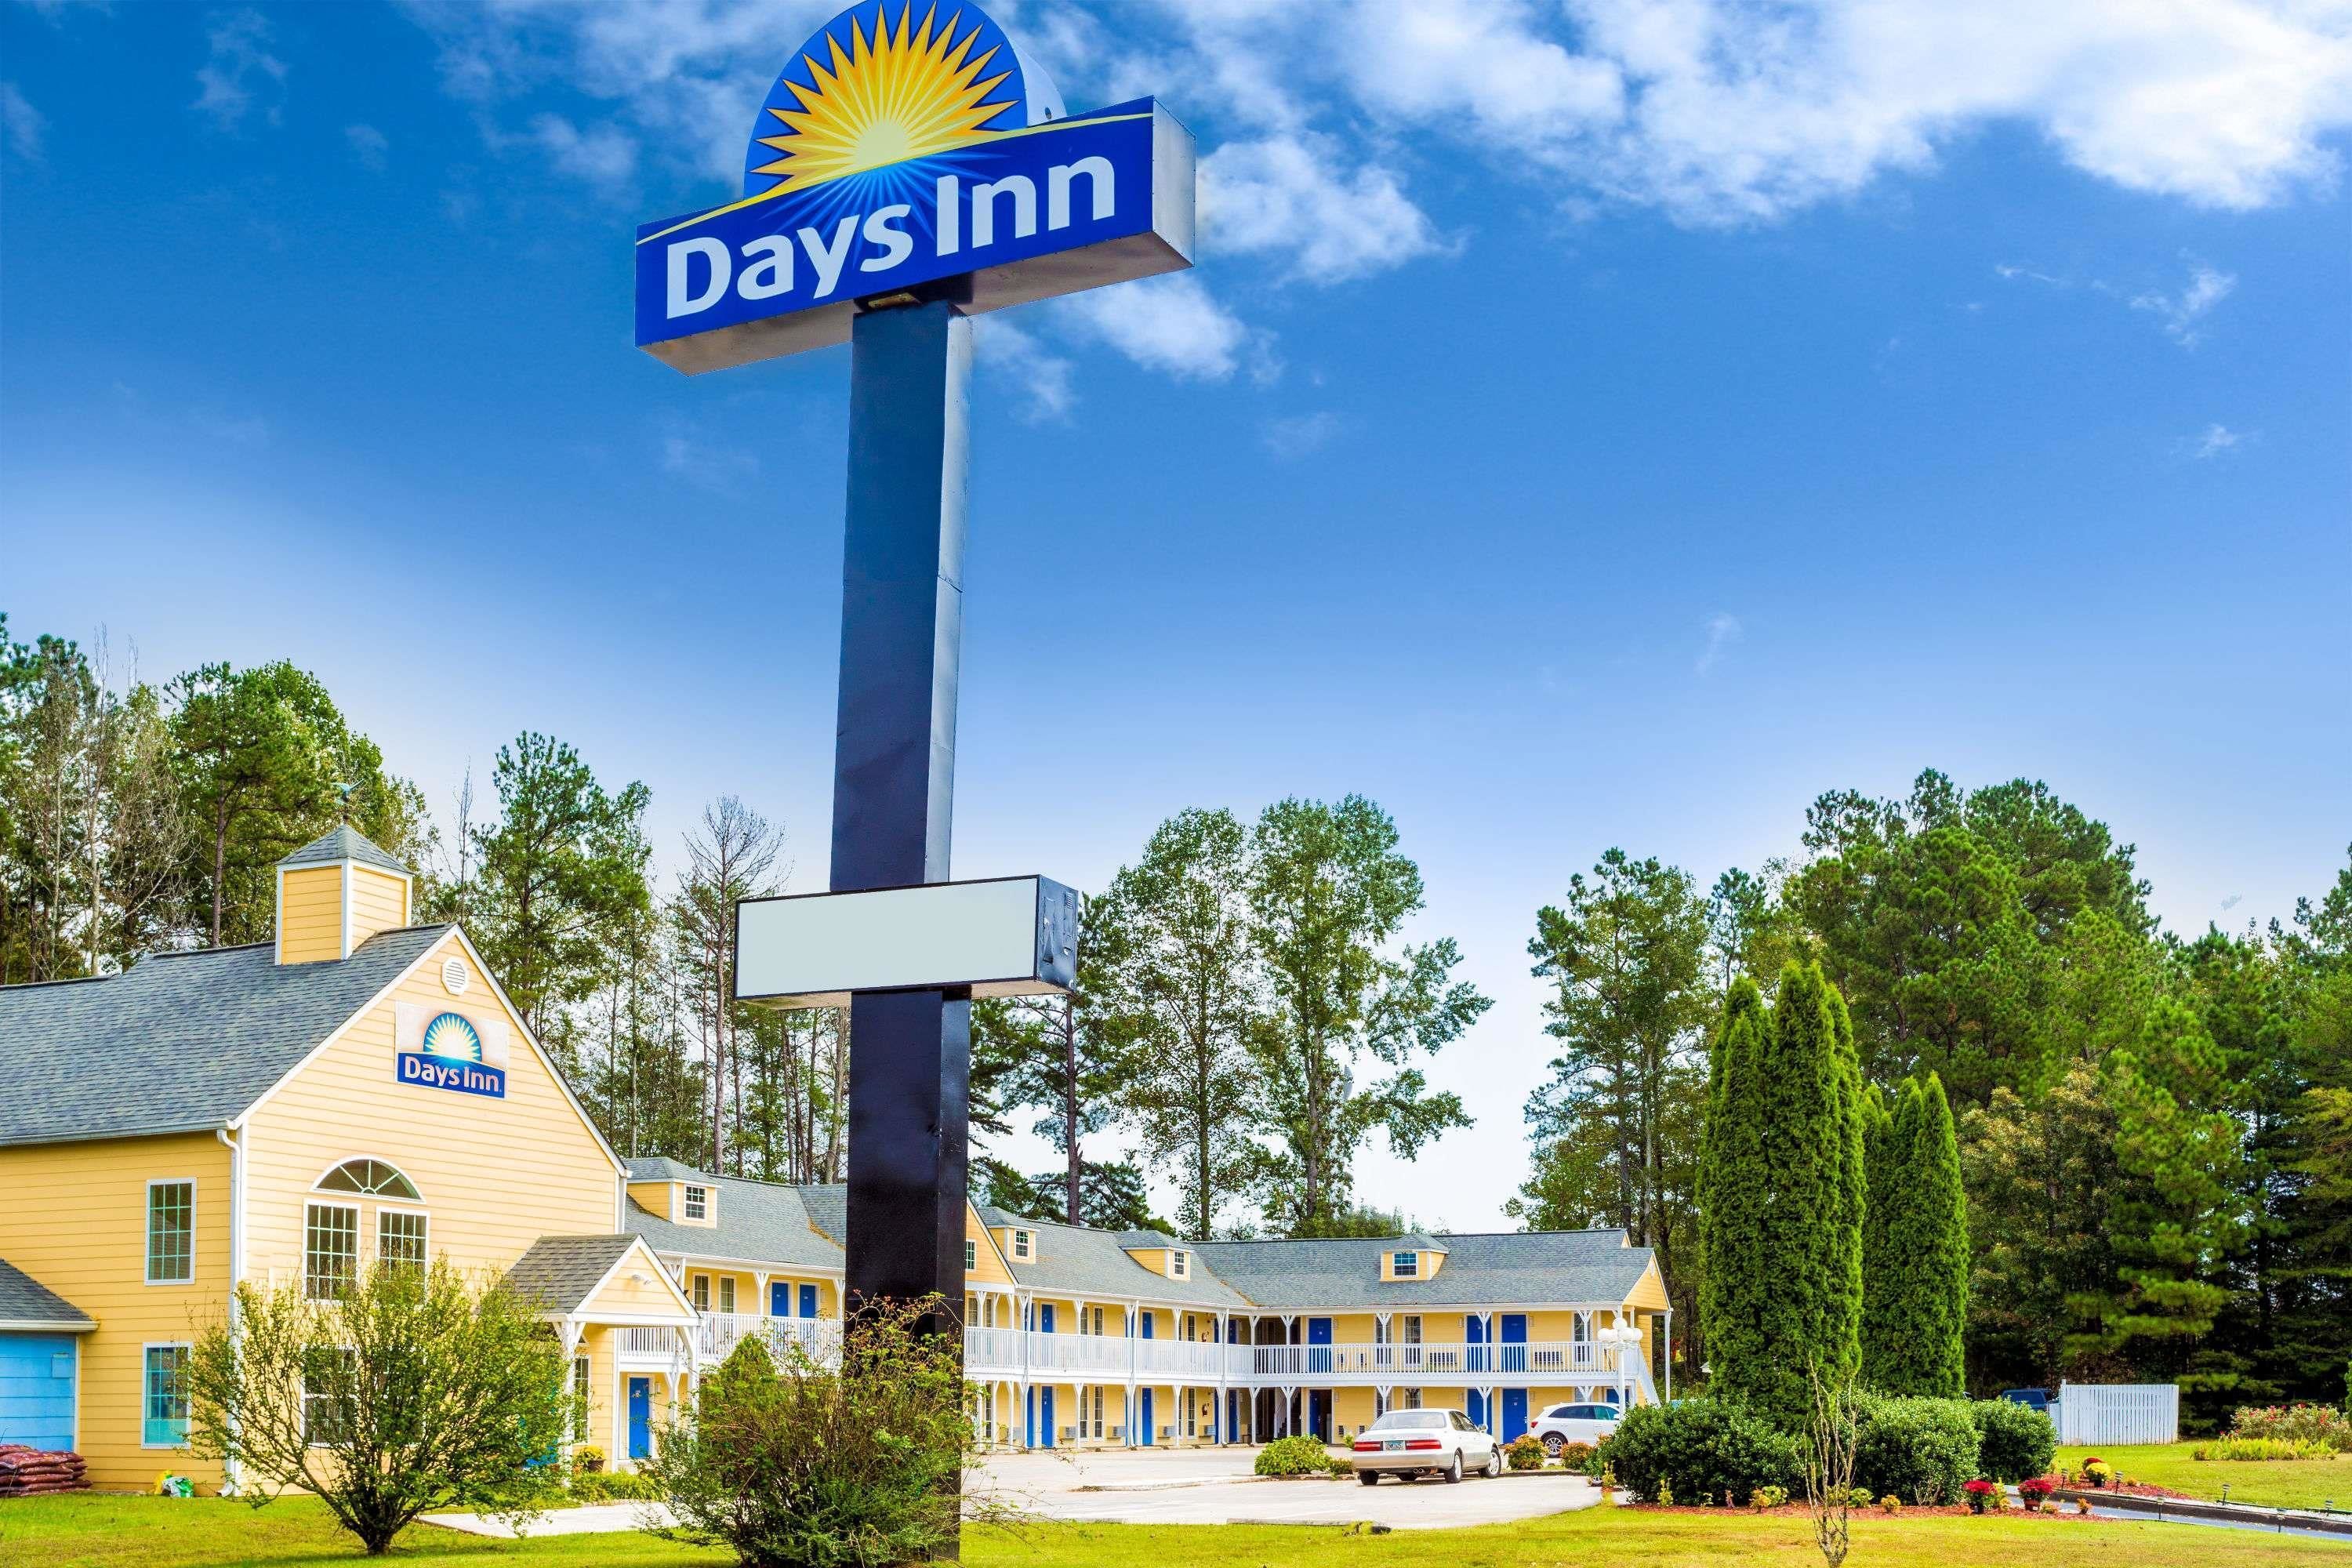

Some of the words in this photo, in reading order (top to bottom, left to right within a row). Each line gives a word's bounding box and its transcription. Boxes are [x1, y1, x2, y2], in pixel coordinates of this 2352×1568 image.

[666, 204, 913, 319] Days
[936, 156, 1115, 256] Inn
[405, 1056, 461, 1087] Days
[463, 1066, 499, 1092] Inn
